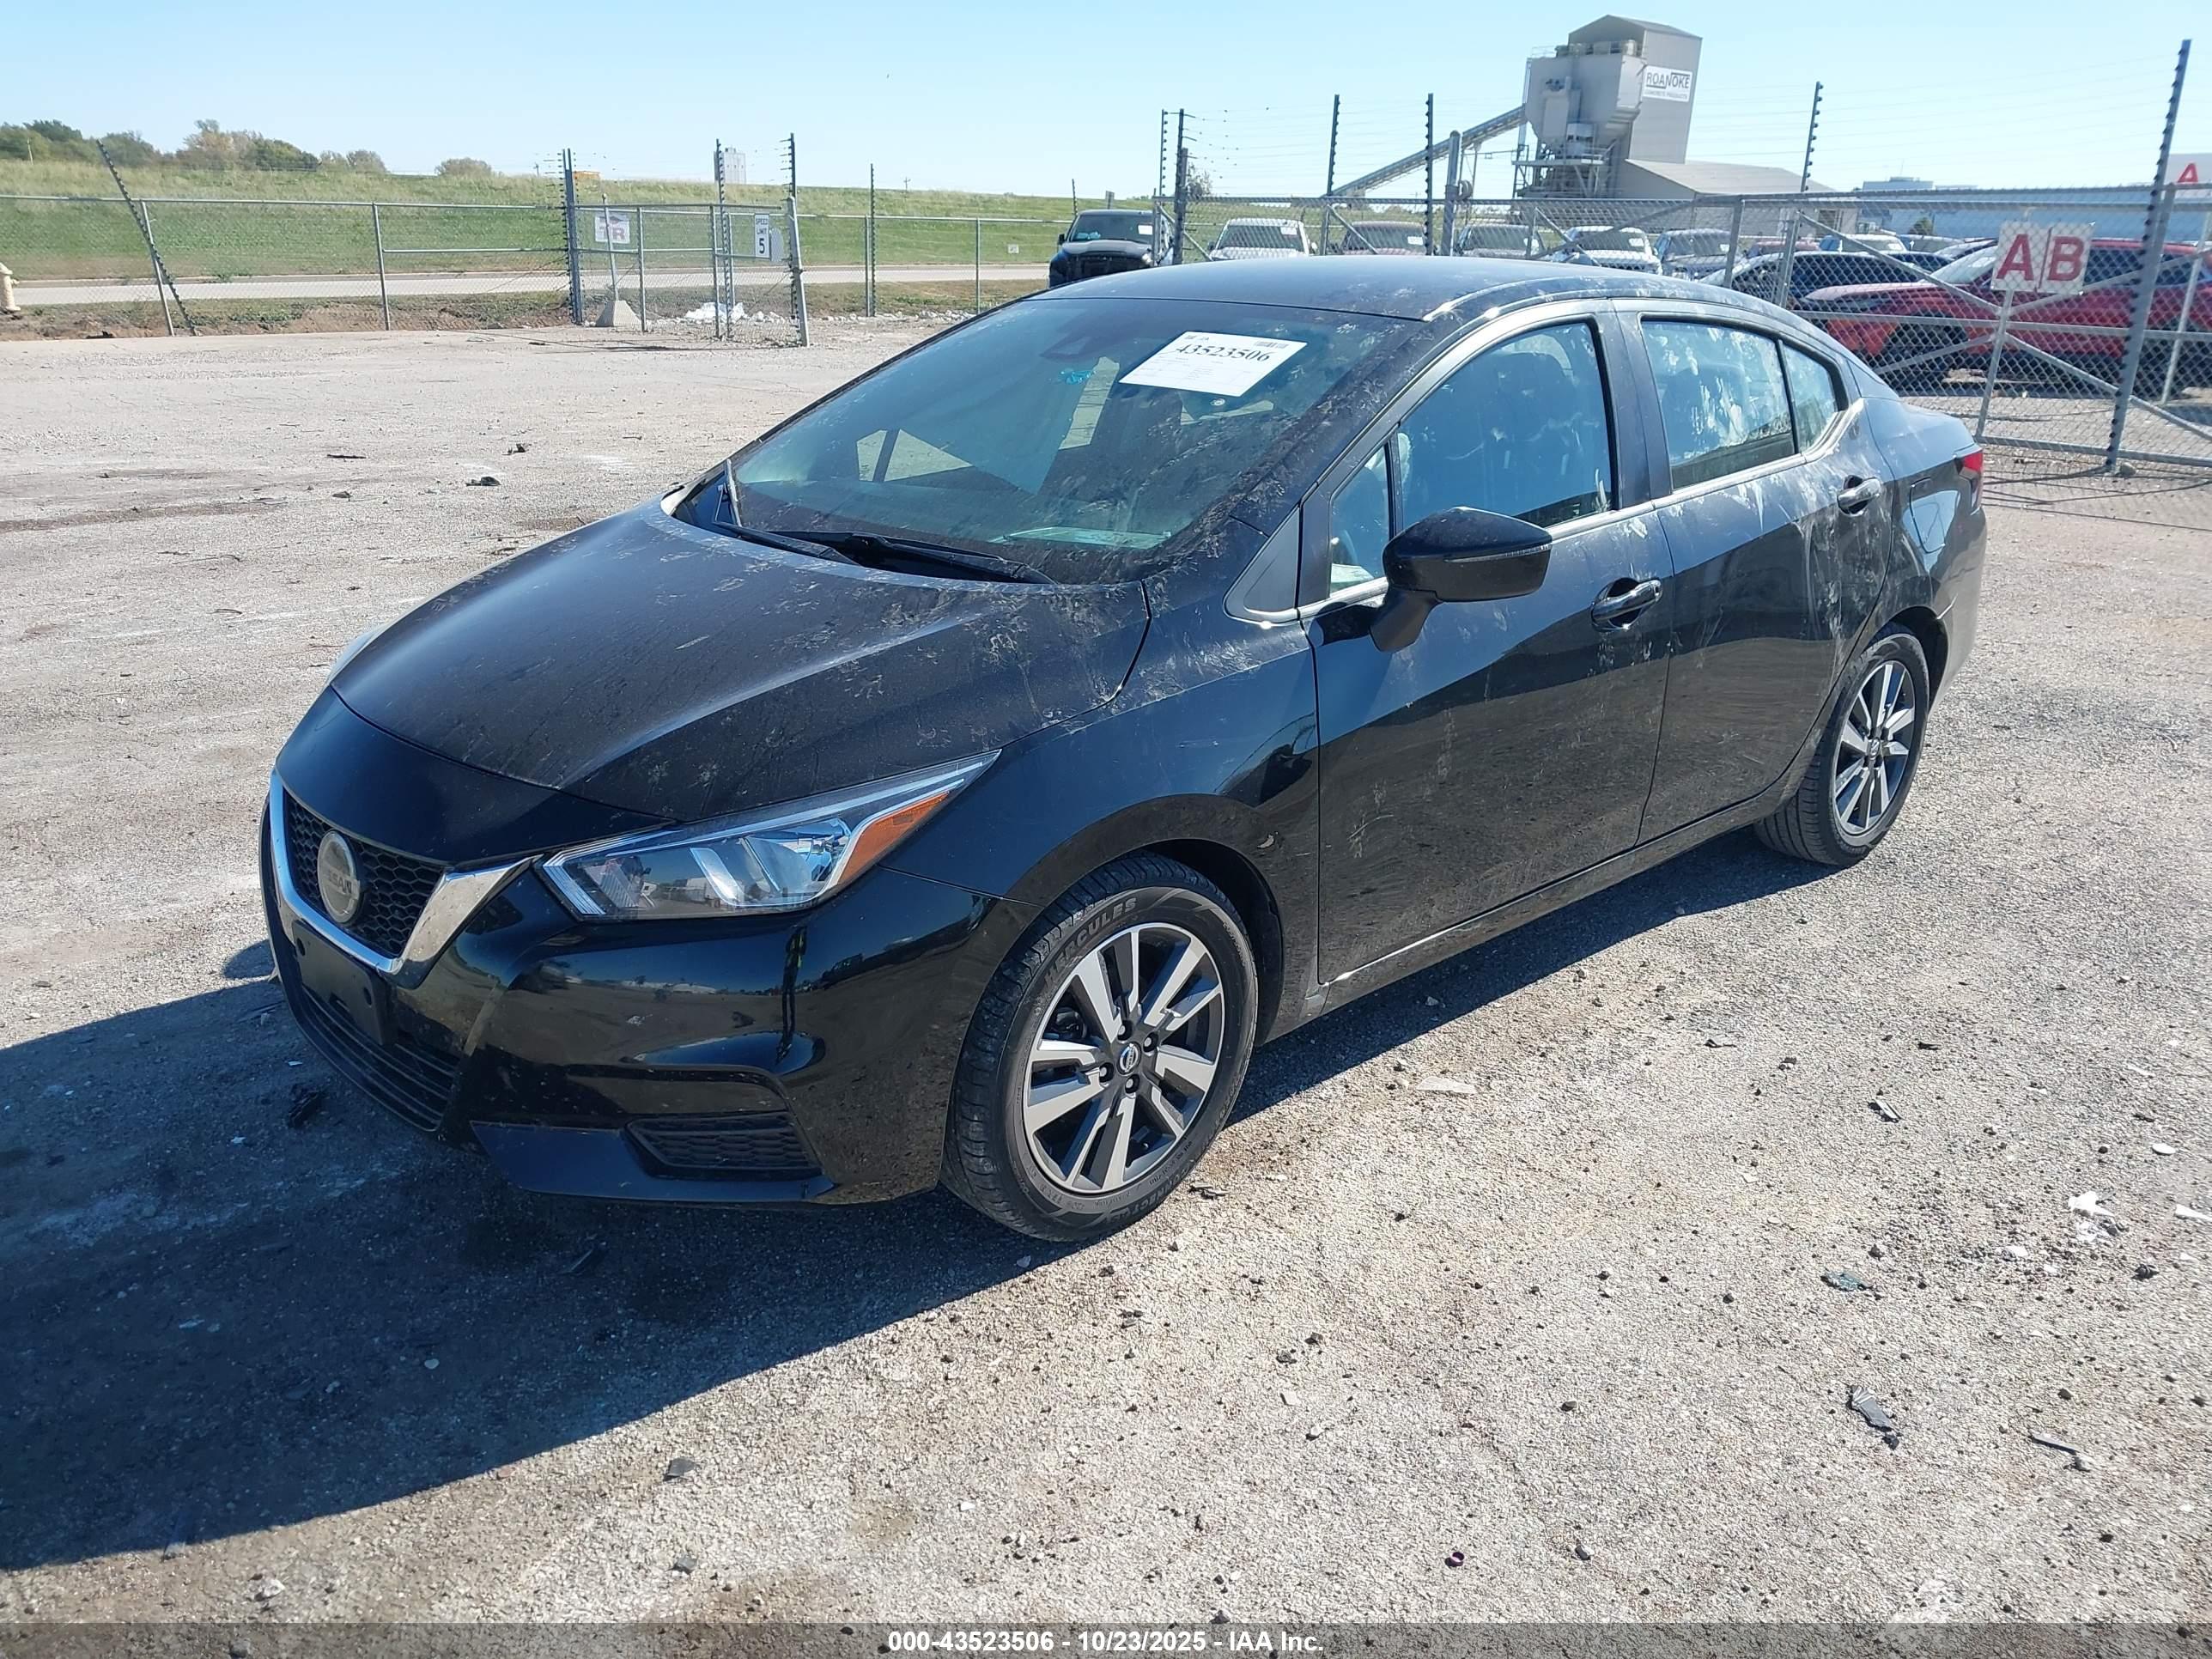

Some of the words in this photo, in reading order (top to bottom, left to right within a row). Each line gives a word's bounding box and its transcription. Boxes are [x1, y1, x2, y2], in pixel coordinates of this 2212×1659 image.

[1646, 72, 1690, 89] ROANOKE
[759, 238, 765, 254] 5
[1176, 343, 1275, 362] 43523506
[1044, 897, 1137, 984] HERCULES
